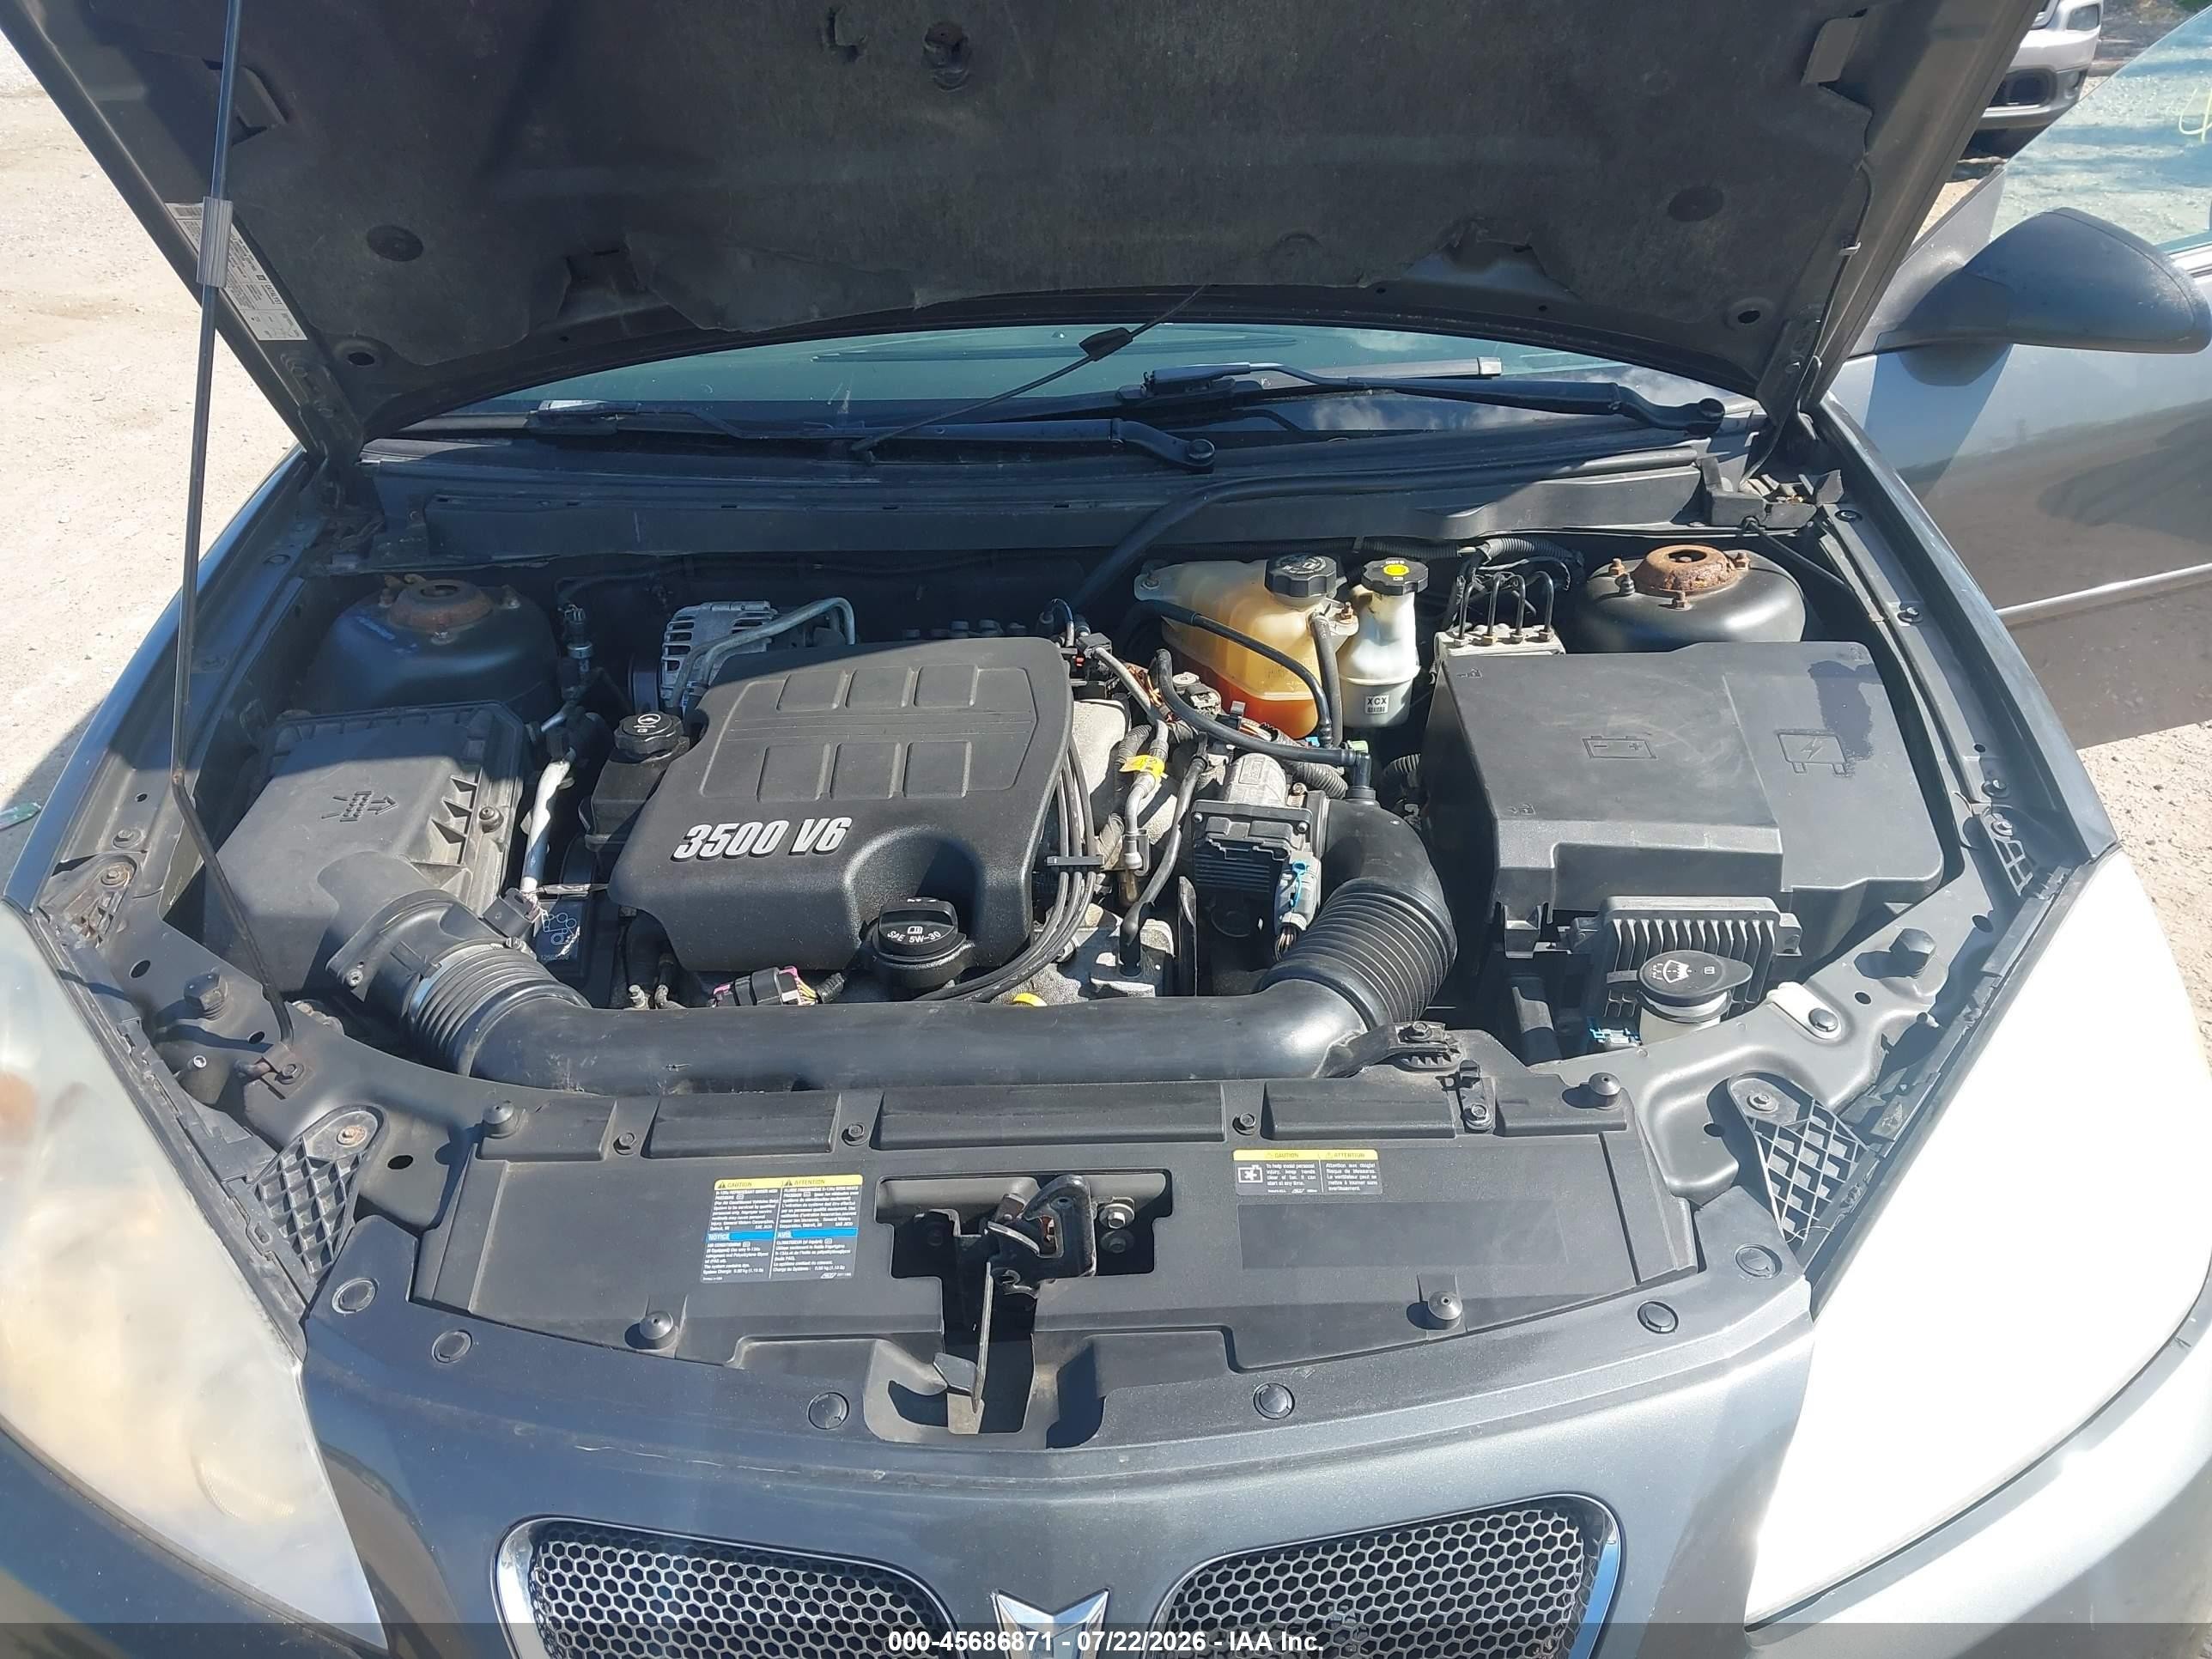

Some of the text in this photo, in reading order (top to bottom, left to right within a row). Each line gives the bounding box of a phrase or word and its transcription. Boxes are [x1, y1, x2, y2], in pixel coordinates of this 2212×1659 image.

[672, 817, 852, 860] 3500 V6
[887, 930, 942, 943] SAE 5W-30
